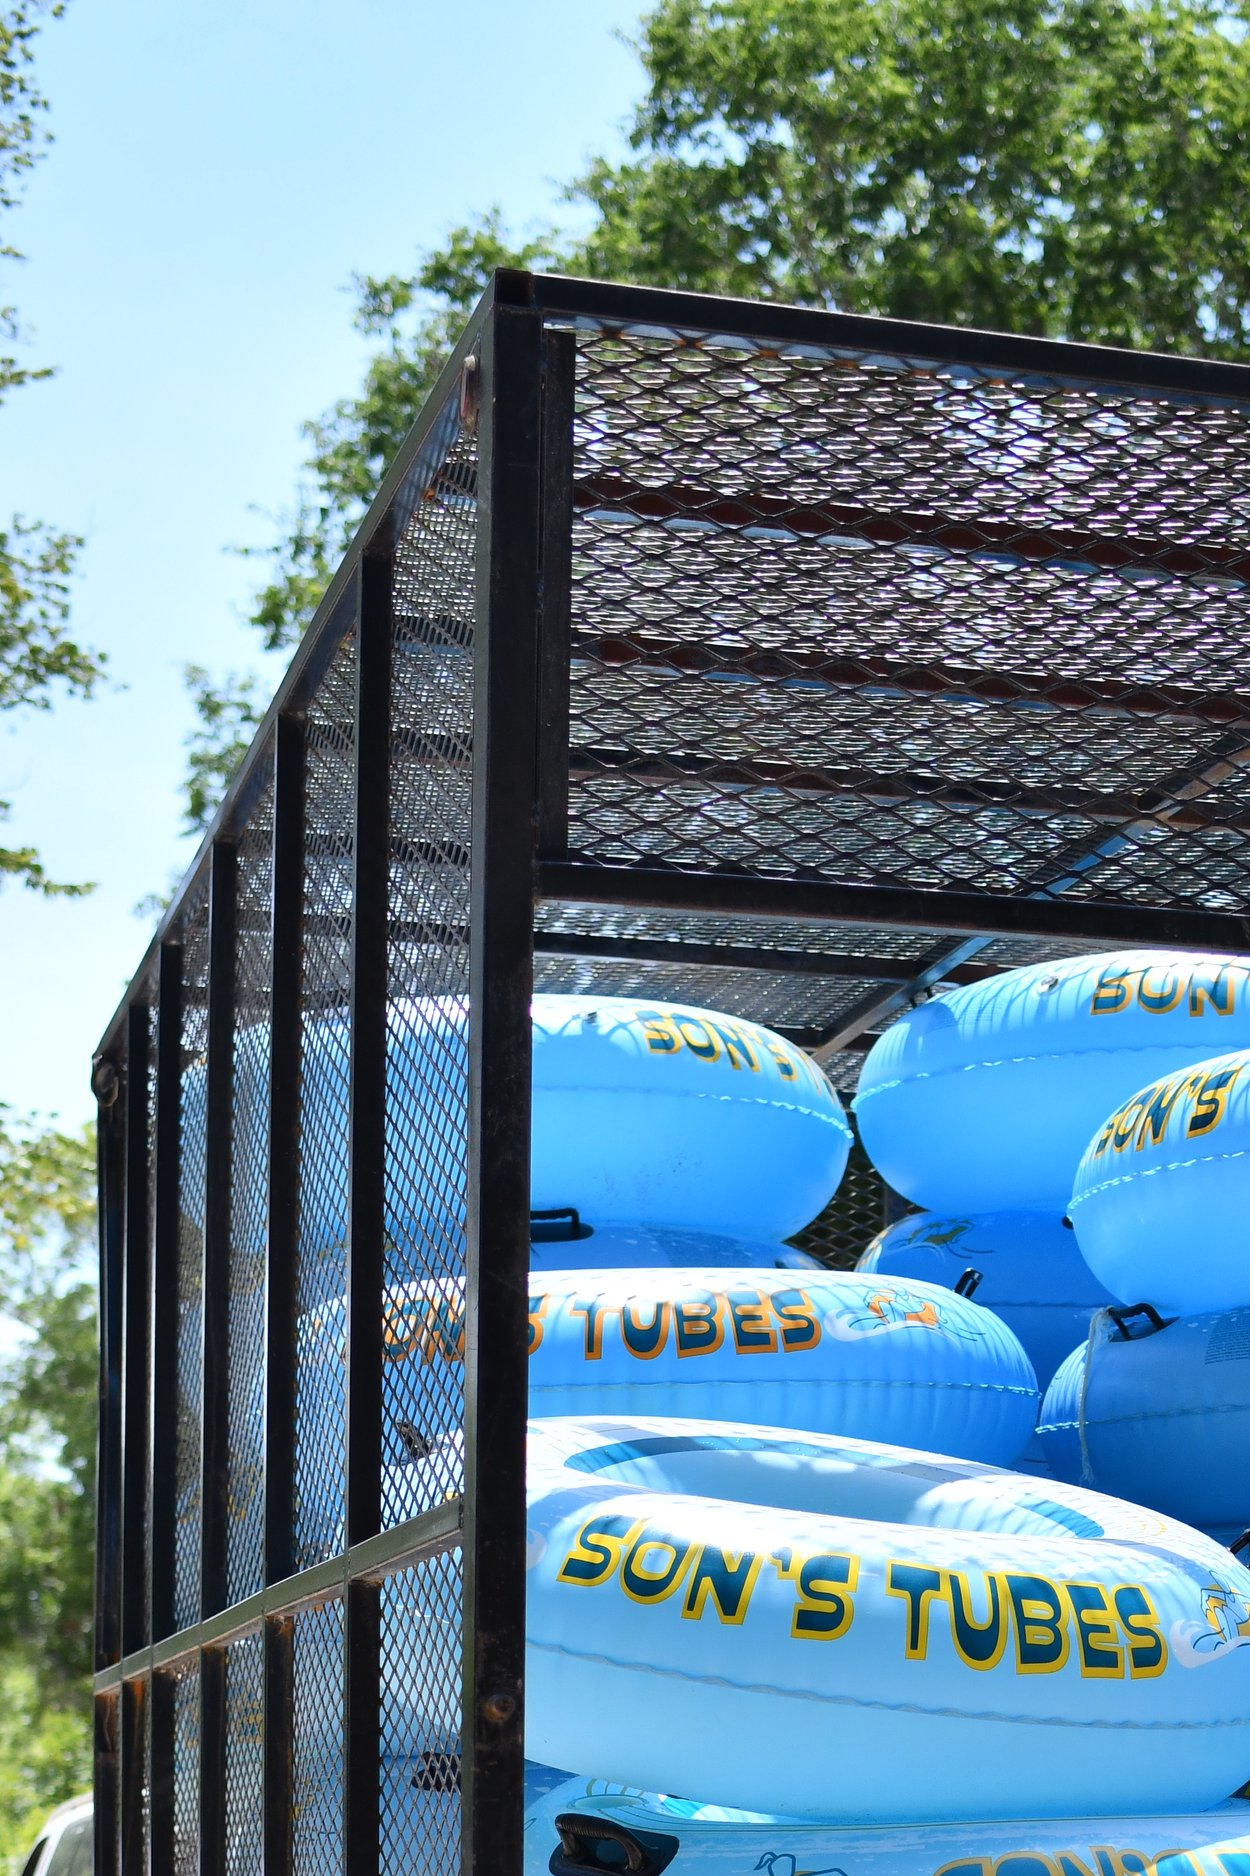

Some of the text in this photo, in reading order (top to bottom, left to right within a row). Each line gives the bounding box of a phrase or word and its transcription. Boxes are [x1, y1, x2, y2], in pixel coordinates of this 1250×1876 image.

[568, 1288, 822, 1362] TUBES
[555, 1513, 1168, 1681] SON'S TUBES
